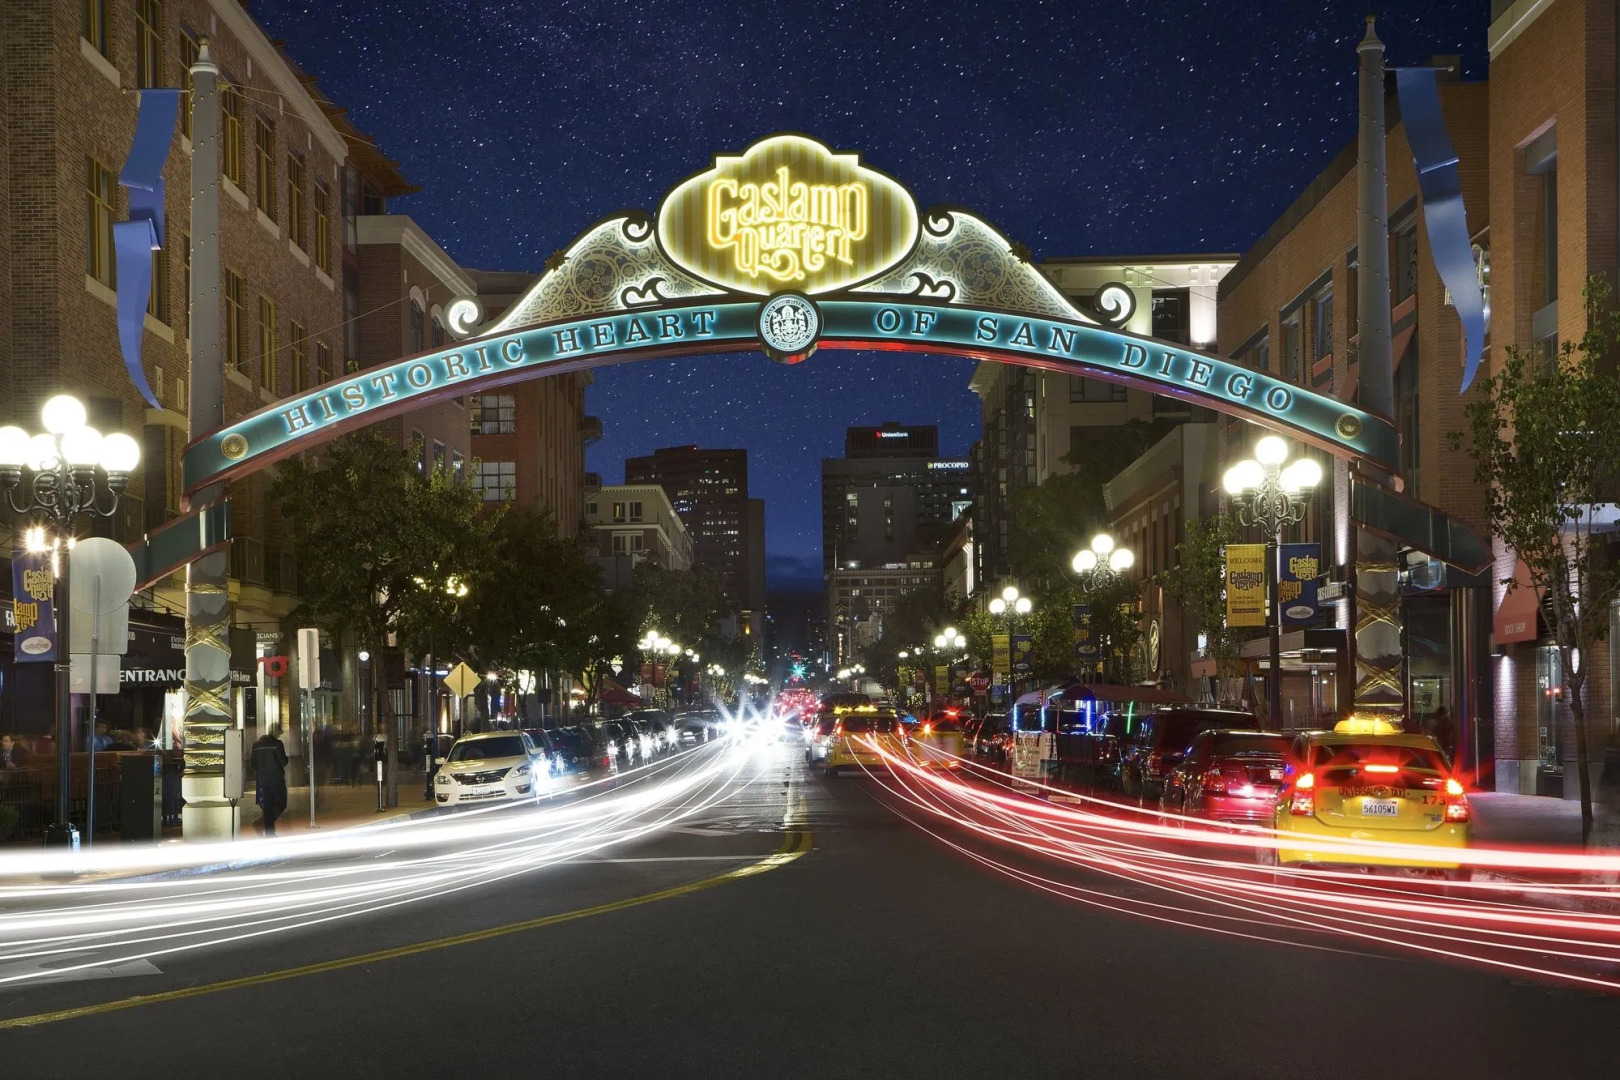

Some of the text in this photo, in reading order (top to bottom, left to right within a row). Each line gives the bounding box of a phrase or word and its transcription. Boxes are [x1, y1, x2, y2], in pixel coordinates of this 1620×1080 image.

[707, 166, 867, 249] Gaslamp
[735, 222, 854, 281] Quarter
[281, 338, 524, 434] HISTORIC
[552, 311, 714, 354] HEART
[876, 308, 936, 335] OF
[977, 317, 1077, 353] SAN
[1120, 343, 1292, 412] DIEGO
[119, 669, 186, 682] ENTRANC
[971, 678, 990, 686] STOP
[1338, 786, 1406, 799] UNIVERSAL TAXI
